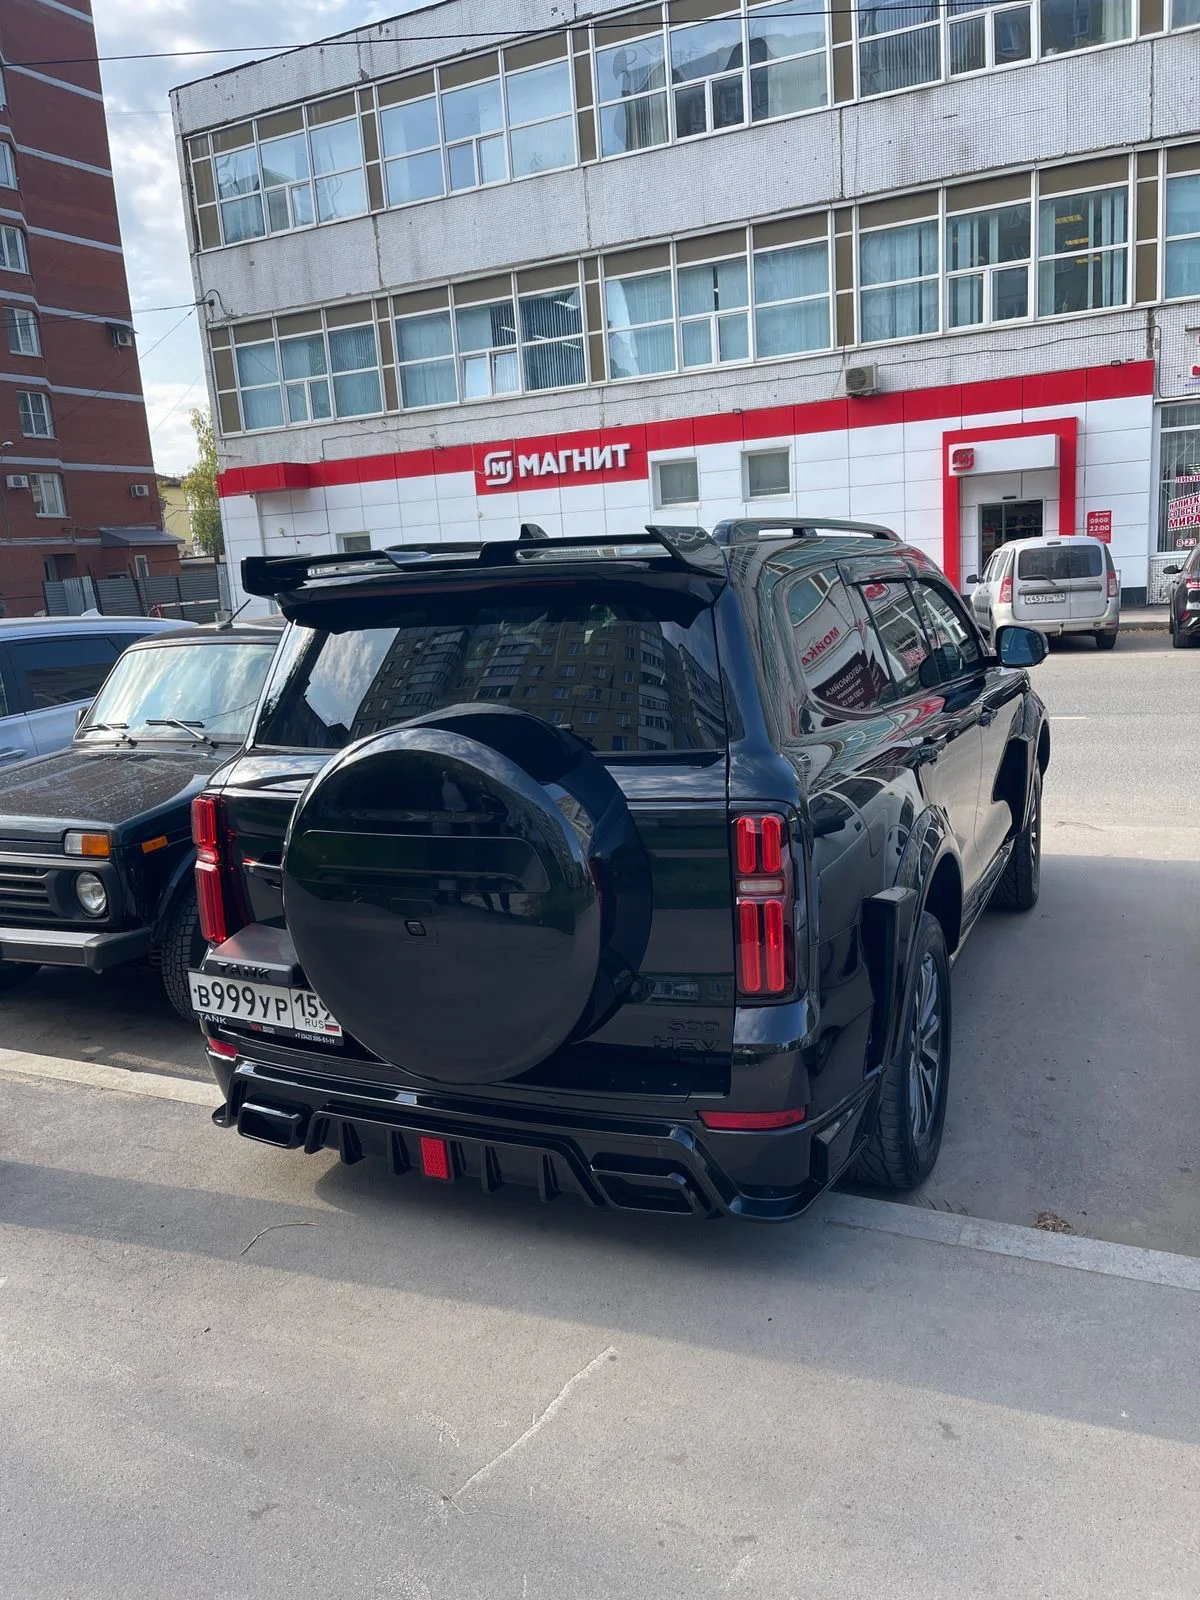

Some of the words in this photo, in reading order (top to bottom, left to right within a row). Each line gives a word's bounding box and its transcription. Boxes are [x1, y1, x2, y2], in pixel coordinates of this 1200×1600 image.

[518, 443, 631, 478] МАГНИТ
[217, 962, 272, 979] TANK
[197, 981, 288, 1021] В999УР
[199, 1012, 227, 1025] TANK
[305, 1017, 325, 1029] RUS
